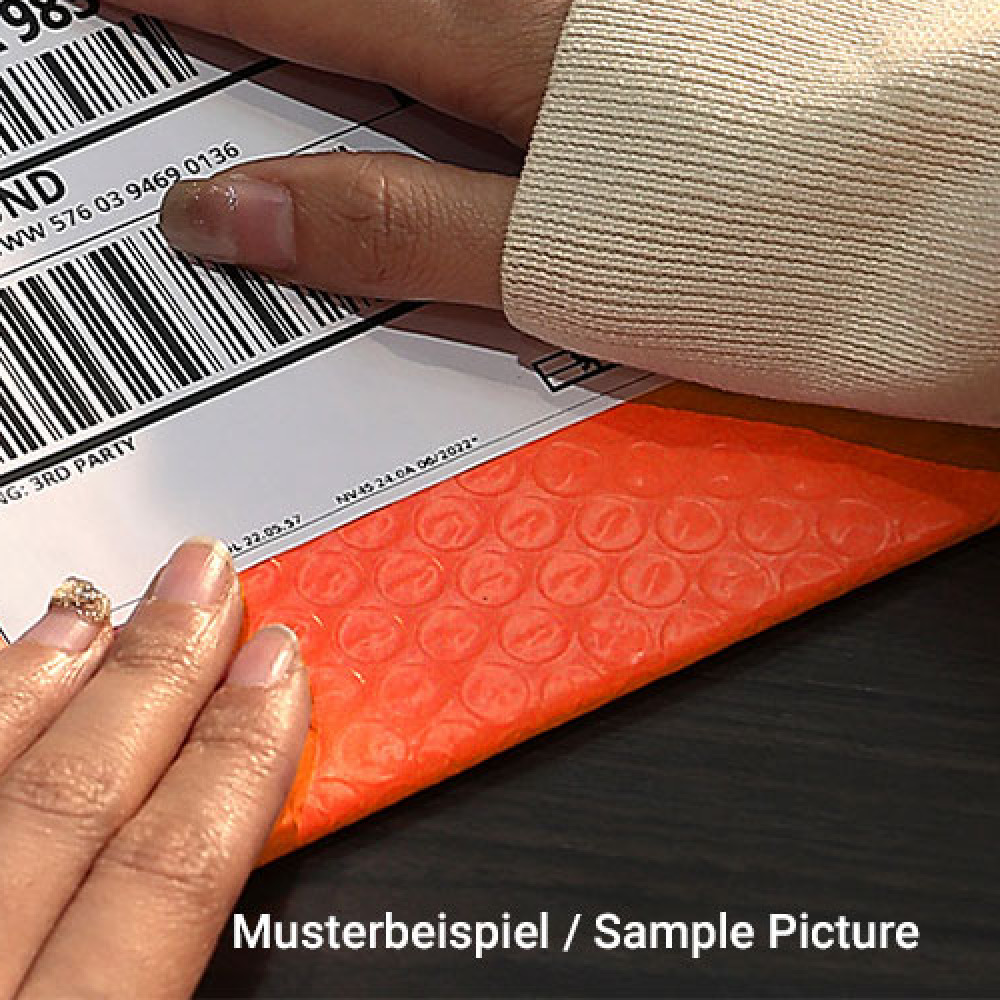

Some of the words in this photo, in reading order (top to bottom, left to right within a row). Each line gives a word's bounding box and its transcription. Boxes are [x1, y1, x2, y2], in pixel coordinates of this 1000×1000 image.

[49, 203, 93, 232] 576
[94, 191, 125, 212] 03
[125, 166, 181, 201] 9469
[183, 141, 240, 175] 0136
[29, 465, 71, 492] 3RD
[73, 436, 136, 473] PARTY
